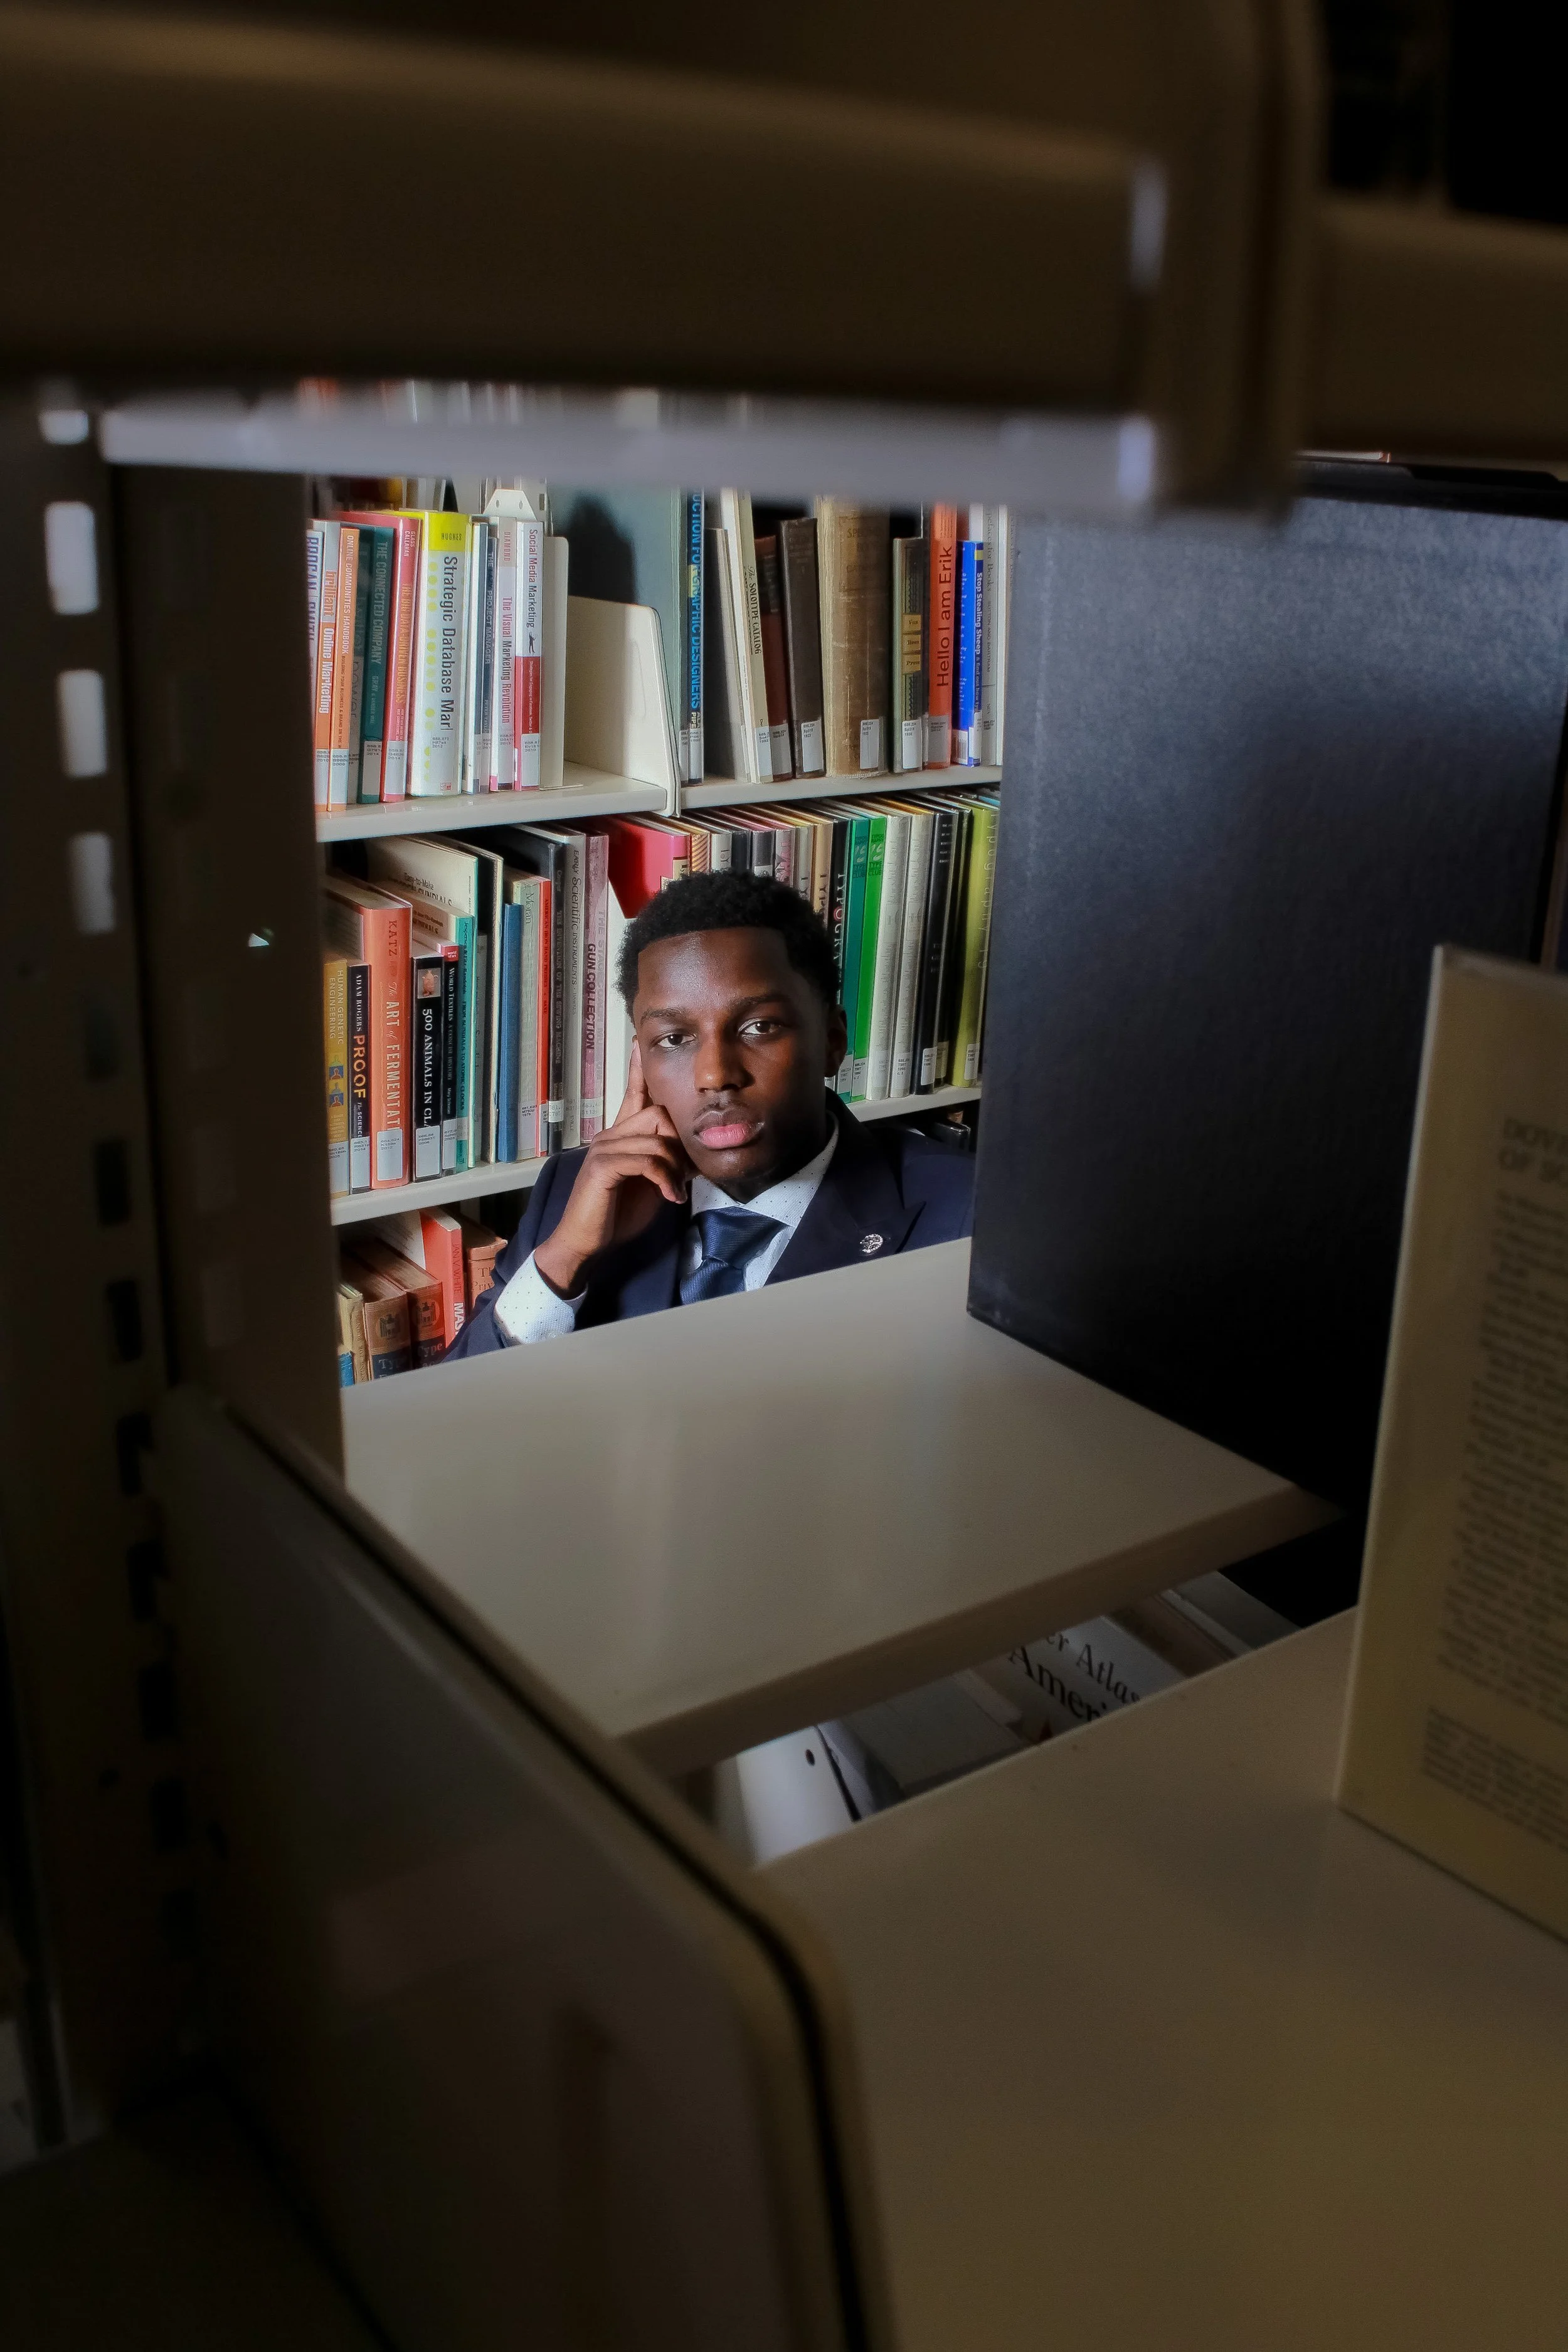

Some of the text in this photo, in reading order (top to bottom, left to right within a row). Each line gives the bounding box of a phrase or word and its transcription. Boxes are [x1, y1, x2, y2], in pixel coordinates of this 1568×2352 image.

[403, 530, 411, 557] CALLAHAN
[441, 532, 462, 541] HUGHES
[503, 531, 511, 562] DIAMOND
[691, 546, 701, 568] FOR
[747, 565, 756, 581] The
[938, 546, 953, 585] Erik
[323, 571, 337, 616] brilliant
[341, 535, 355, 654] ONLINE COMMUNITIES HANDBOOK
[526, 529, 538, 628] Social Media Marketing
[975, 572, 983, 592] Stop
[986, 563, 994, 592] Books
[371, 541, 388, 665] THE CONNECTED COMPANY
[485, 590, 494, 625] PROJECT
[502, 596, 513, 613] The
[690, 570, 701, 635] GRAPHIC
[749, 583, 760, 620] SOLOTYPE
[940, 590, 951, 621] am
[973, 593, 983, 628] Stealing
[440, 556, 458, 730] Strategic Database Mar
[502, 614, 512, 638] Visual
[751, 622, 762, 655] CATALOG
[973, 629, 982, 655] Sheep
[485, 626, 493, 664] MANAGER
[501, 640, 512, 681] Marketing
[936, 637, 950, 687] Hello
[319, 628, 334, 713] Online Marketing
[395, 665, 410, 703] BUSINESS
[690, 637, 701, 709] DESIGNERS
[501, 683, 512, 724] Revolution
[525, 892, 534, 924] Moran
[570, 850, 582, 985] EARLY Scientific INSTRUMENTS
[388, 919, 398, 956] KATZ
[387, 982, 398, 997] The
[556, 972, 563, 982] OF
[385, 1000, 400, 1027] ART
[586, 943, 596, 1050] GUN COLLECTION
[386, 1030, 398, 1039] of
[422, 1008, 433, 1031] 500
[352, 1034, 366, 1098] PROOF
[423, 1034, 433, 1088] ANIMALS
[460, 1052, 466, 1061] TO
[424, 1091, 432, 1104] IN
[452, 1243, 462, 1294] JAN V WHITE
